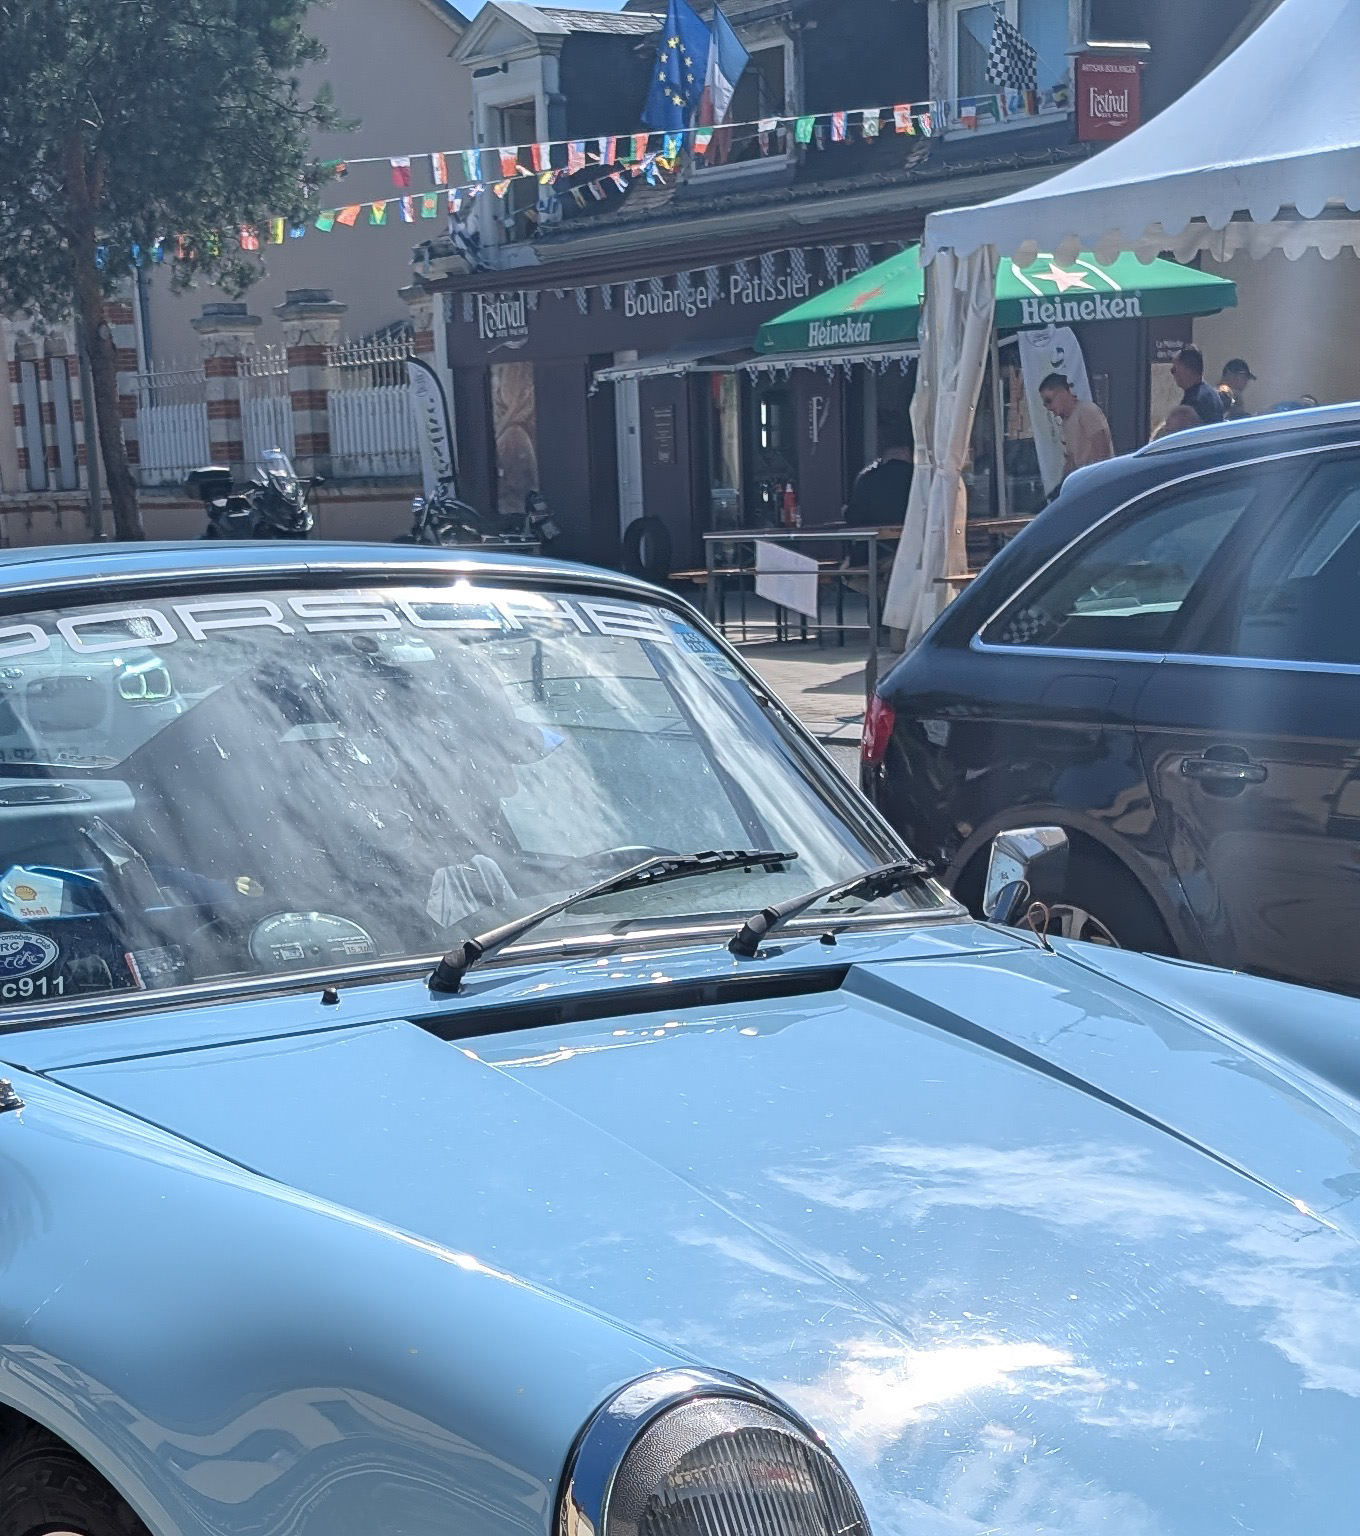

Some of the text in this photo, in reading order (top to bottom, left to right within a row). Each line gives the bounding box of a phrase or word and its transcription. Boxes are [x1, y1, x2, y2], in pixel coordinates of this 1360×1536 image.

[1089, 87, 1129, 118] Festival
[1018, 294, 1143, 325] Heineken
[807, 317, 872, 348] Heineken
[20, 906, 50, 917] Shell
